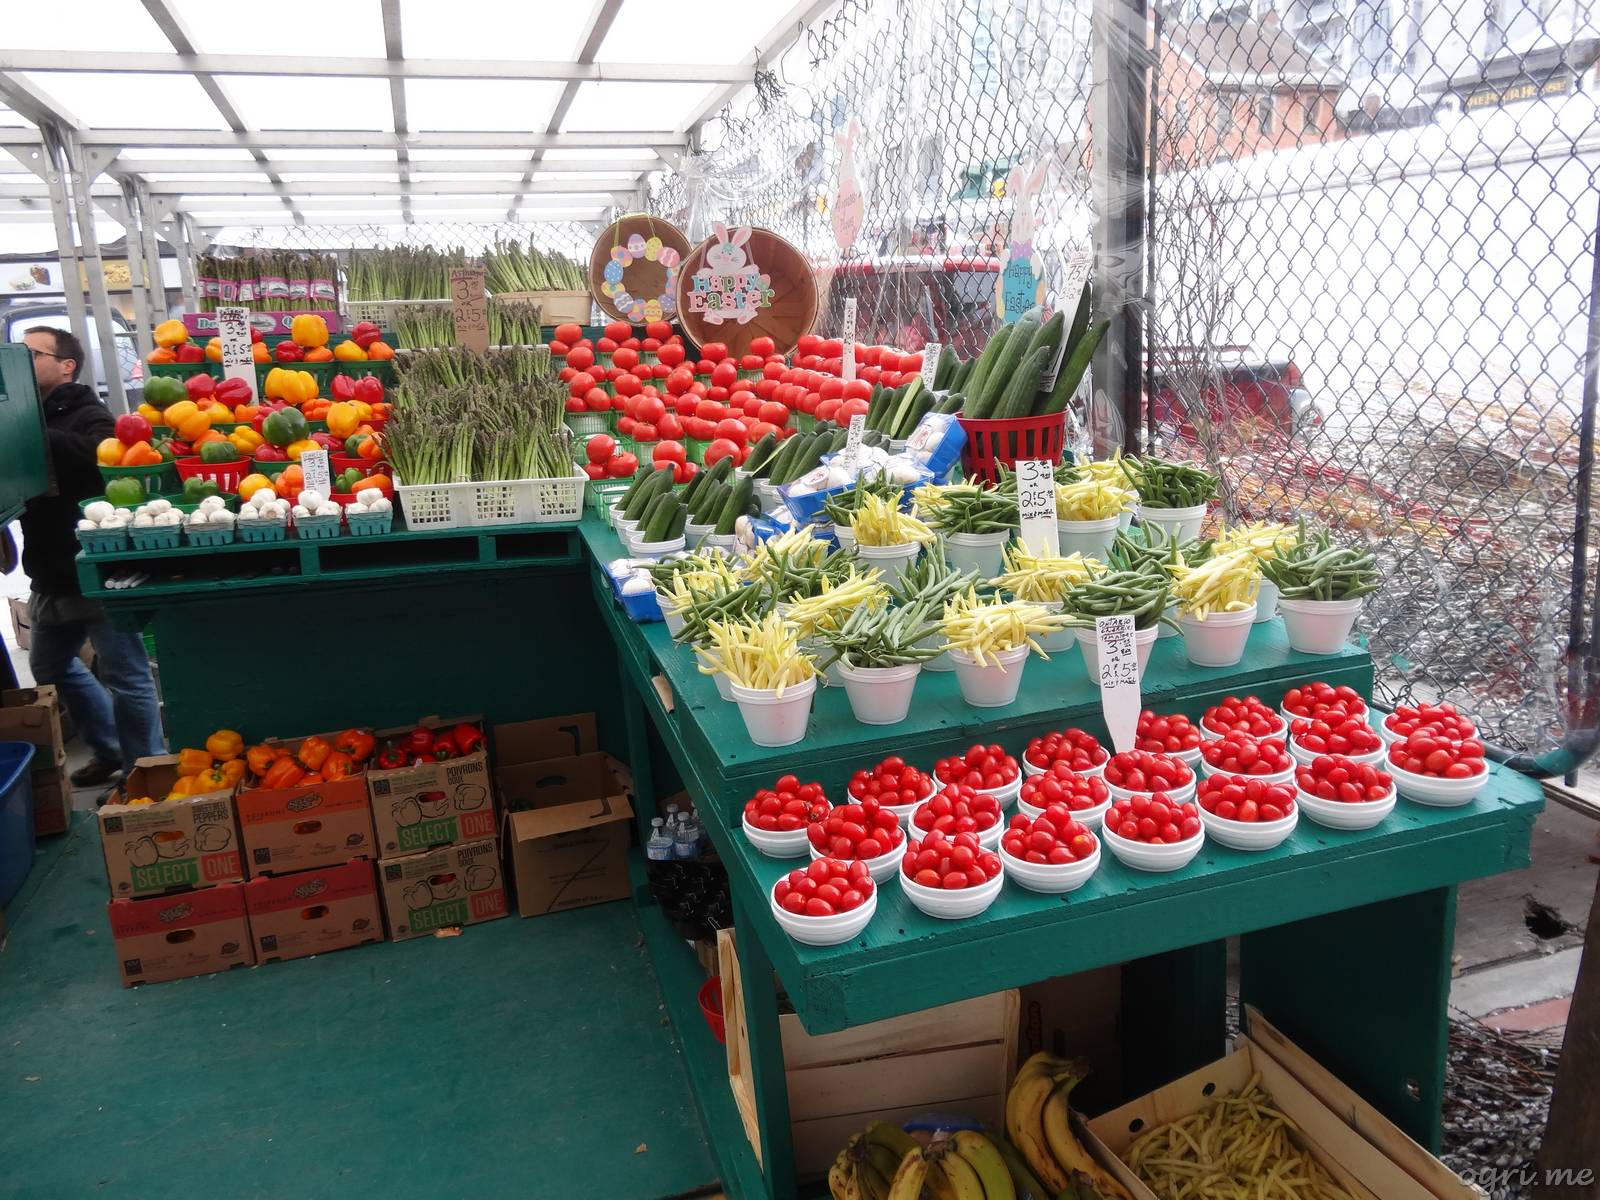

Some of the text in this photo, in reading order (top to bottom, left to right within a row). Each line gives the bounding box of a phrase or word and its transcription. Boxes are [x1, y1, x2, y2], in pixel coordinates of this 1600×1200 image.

[690, 274, 759, 293] Happy
[1007, 260, 1033, 289] Happy
[687, 290, 775, 312] Easter
[447, 761, 484, 777] POIVRONS
[193, 808, 229, 823] PEPPERS
[402, 814, 496, 847] SELECT ONE
[458, 843, 494, 859] POIVRONS
[136, 855, 239, 888] SELECT ONE
[413, 892, 505, 930] SELECT ONE
